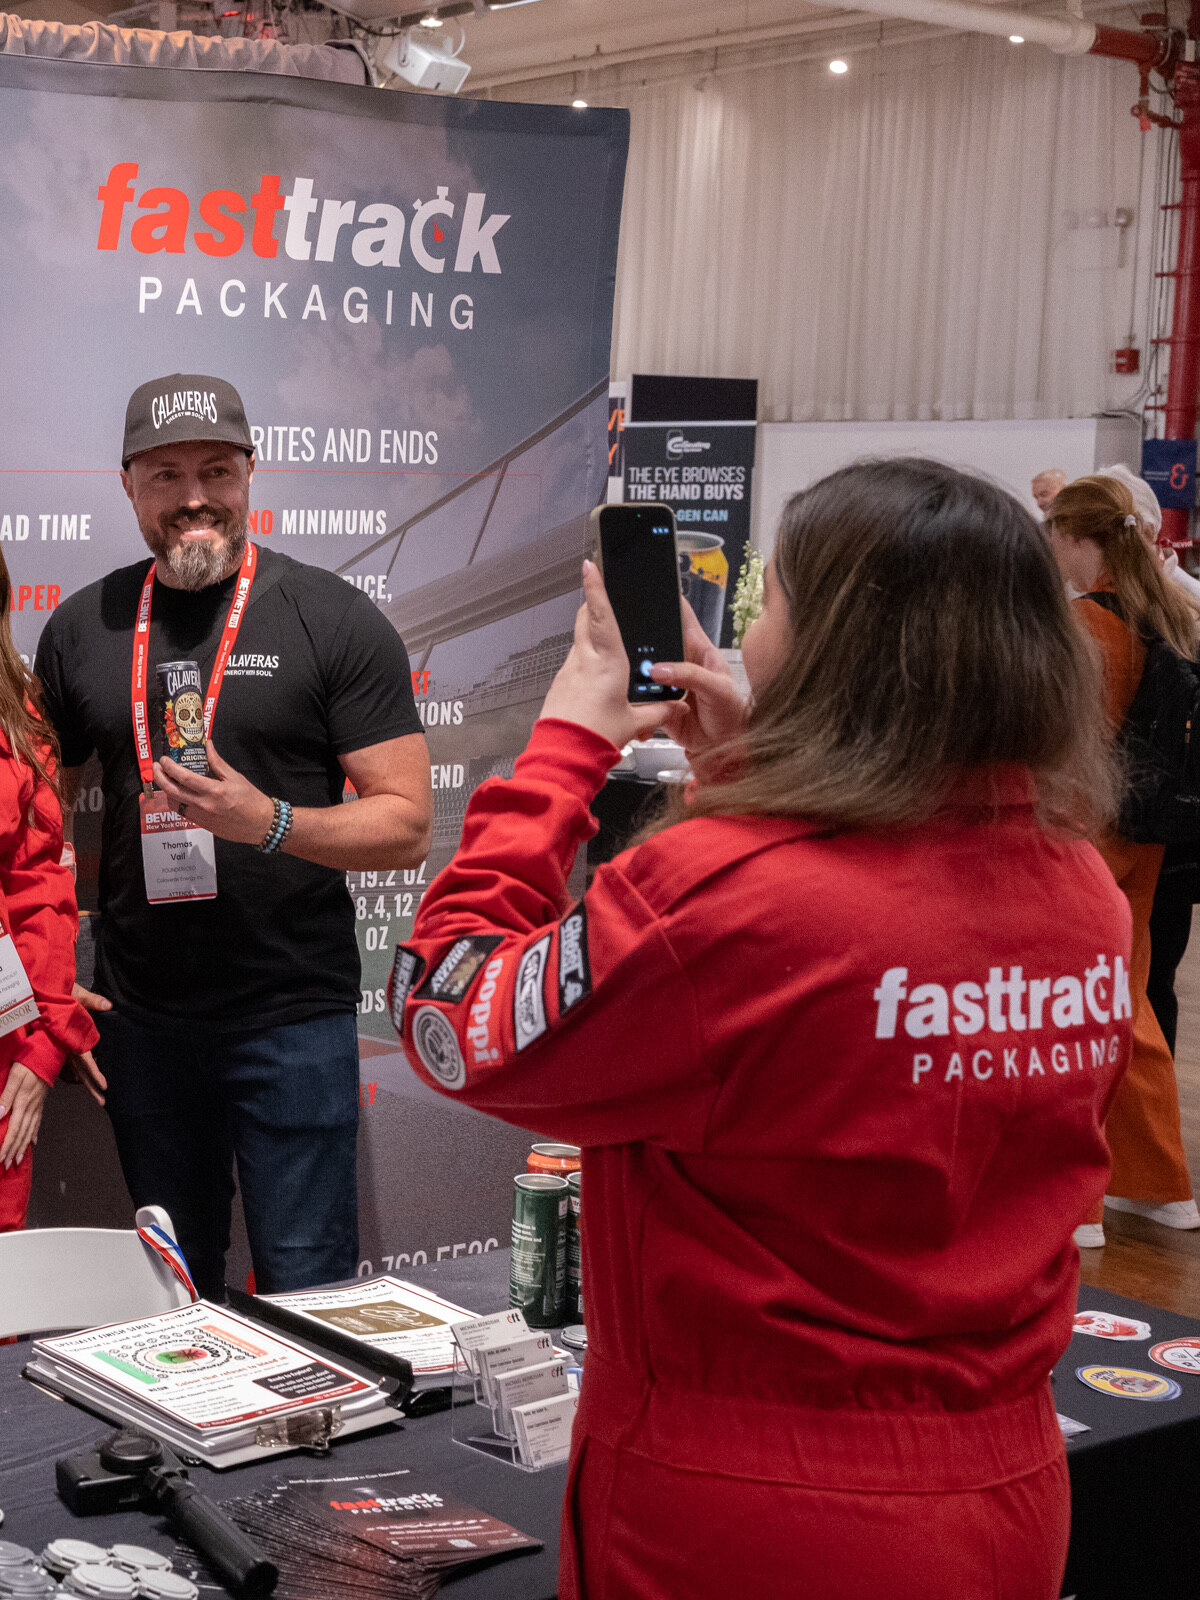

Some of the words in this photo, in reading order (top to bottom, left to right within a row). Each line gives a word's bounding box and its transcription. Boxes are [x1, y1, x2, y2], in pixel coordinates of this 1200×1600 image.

[96, 162, 511, 275] fasttrack
[138, 276, 476, 330] PACKAGING
[151, 390, 218, 430] CALAVERAS
[250, 425, 316, 462] RITES
[323, 427, 372, 464] AND
[379, 429, 439, 465] ENDS
[628, 467, 651, 483] THE
[654, 467, 680, 483] EYE
[682, 466, 746, 483] BROWSES
[628, 484, 657, 501] THE
[659, 484, 701, 501] HAND
[703, 484, 744, 501] BUYS
[39, 513, 92, 541] TIME
[281, 509, 387, 535] MINIMUMS
[674, 509, 702, 522] -GEN
[702, 509, 729, 522] CAN
[233, 577, 250, 614] BEVNET
[226, 654, 279, 669] ALAVERAS
[411, 670, 432, 695] ST
[134, 701, 144, 719] LIVE
[415, 701, 464, 726] IONS
[135, 719, 150, 760] BEVNET
[145, 811, 182, 824] BEVNE
[162, 841, 193, 851] Thomas
[170, 852, 186, 861] Vail
[365, 926, 389, 951] OZ
[357, 988, 386, 1015] DS
[873, 953, 1132, 1039] fasttrack
[912, 1035, 1120, 1084] PACKAGING
